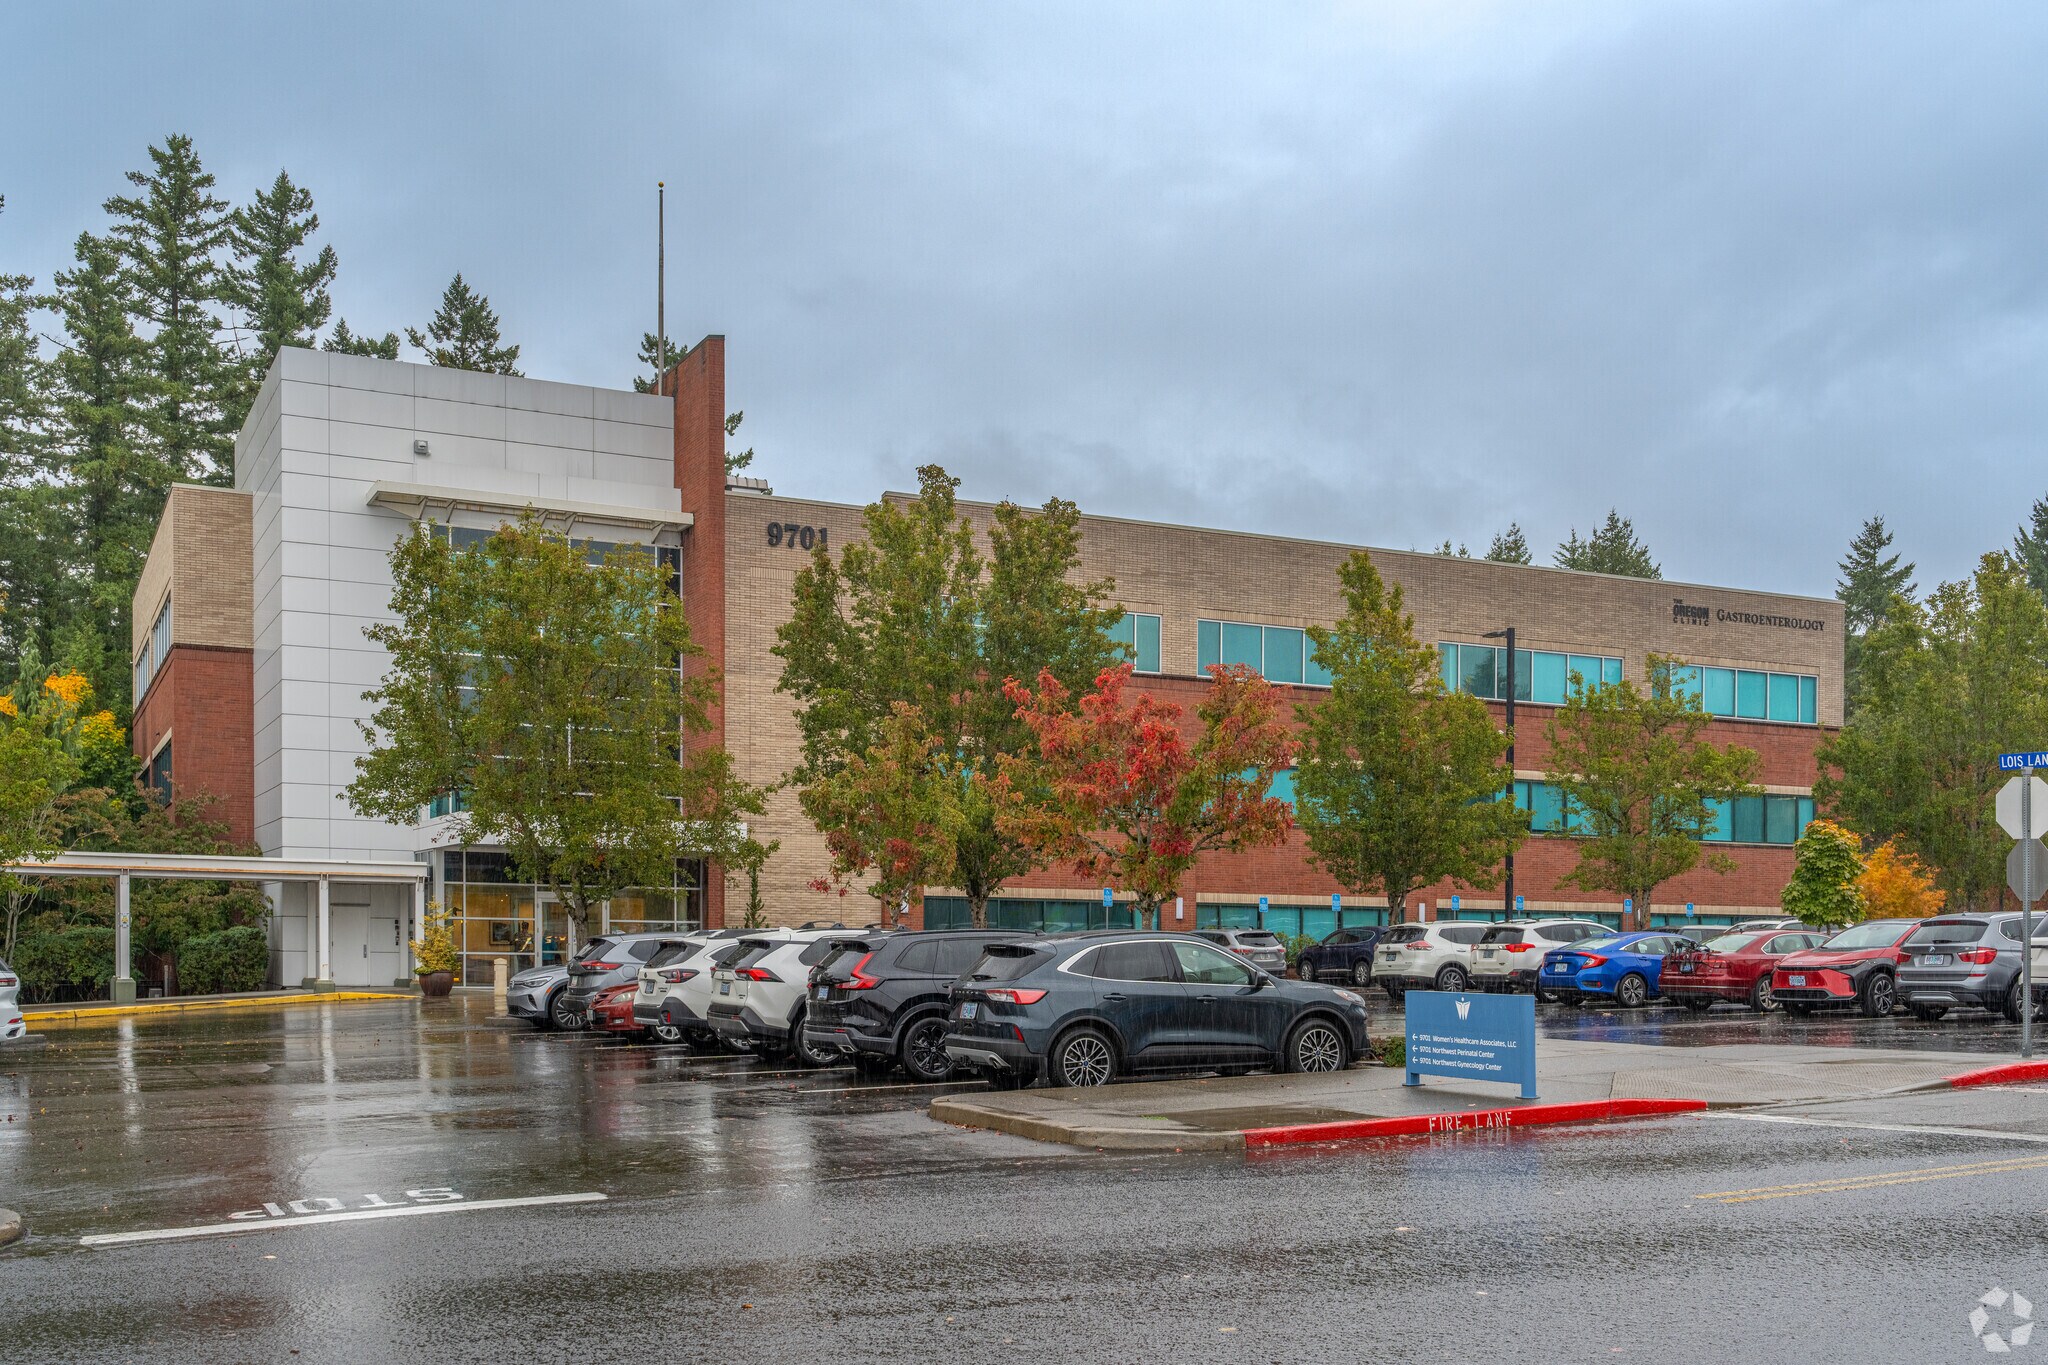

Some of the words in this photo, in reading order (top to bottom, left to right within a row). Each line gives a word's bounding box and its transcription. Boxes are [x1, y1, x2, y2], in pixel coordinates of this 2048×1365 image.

[767, 521, 828, 551] 9701
[1673, 604, 1709, 619] OREGON
[1673, 616, 1709, 626] CLINIC
[2001, 755, 2024, 768] LOIS
[1432, 1035, 1453, 1043] Women's
[1453, 1037, 1479, 1045] Healthcare
[1479, 1039, 1507, 1048] Associates,
[1507, 1040, 1517, 1048] LLC
[1419, 1045, 1431, 1053] 9701
[1432, 1047, 1456, 1055] Northwest
[1457, 1049, 1478, 1057] Perinatal
[1478, 1050, 1495, 1058] Center
[1419, 1057, 1431, 1065] 9701
[1432, 1059, 1457, 1067] Northwest
[1457, 1060, 1485, 1070] Gynecology
[1485, 1063, 1502, 1071] Center
[1429, 1115, 1462, 1133] FIRE
[1475, 1111, 1512, 1129] LANE
[227, 1187, 464, 1219] STOP
